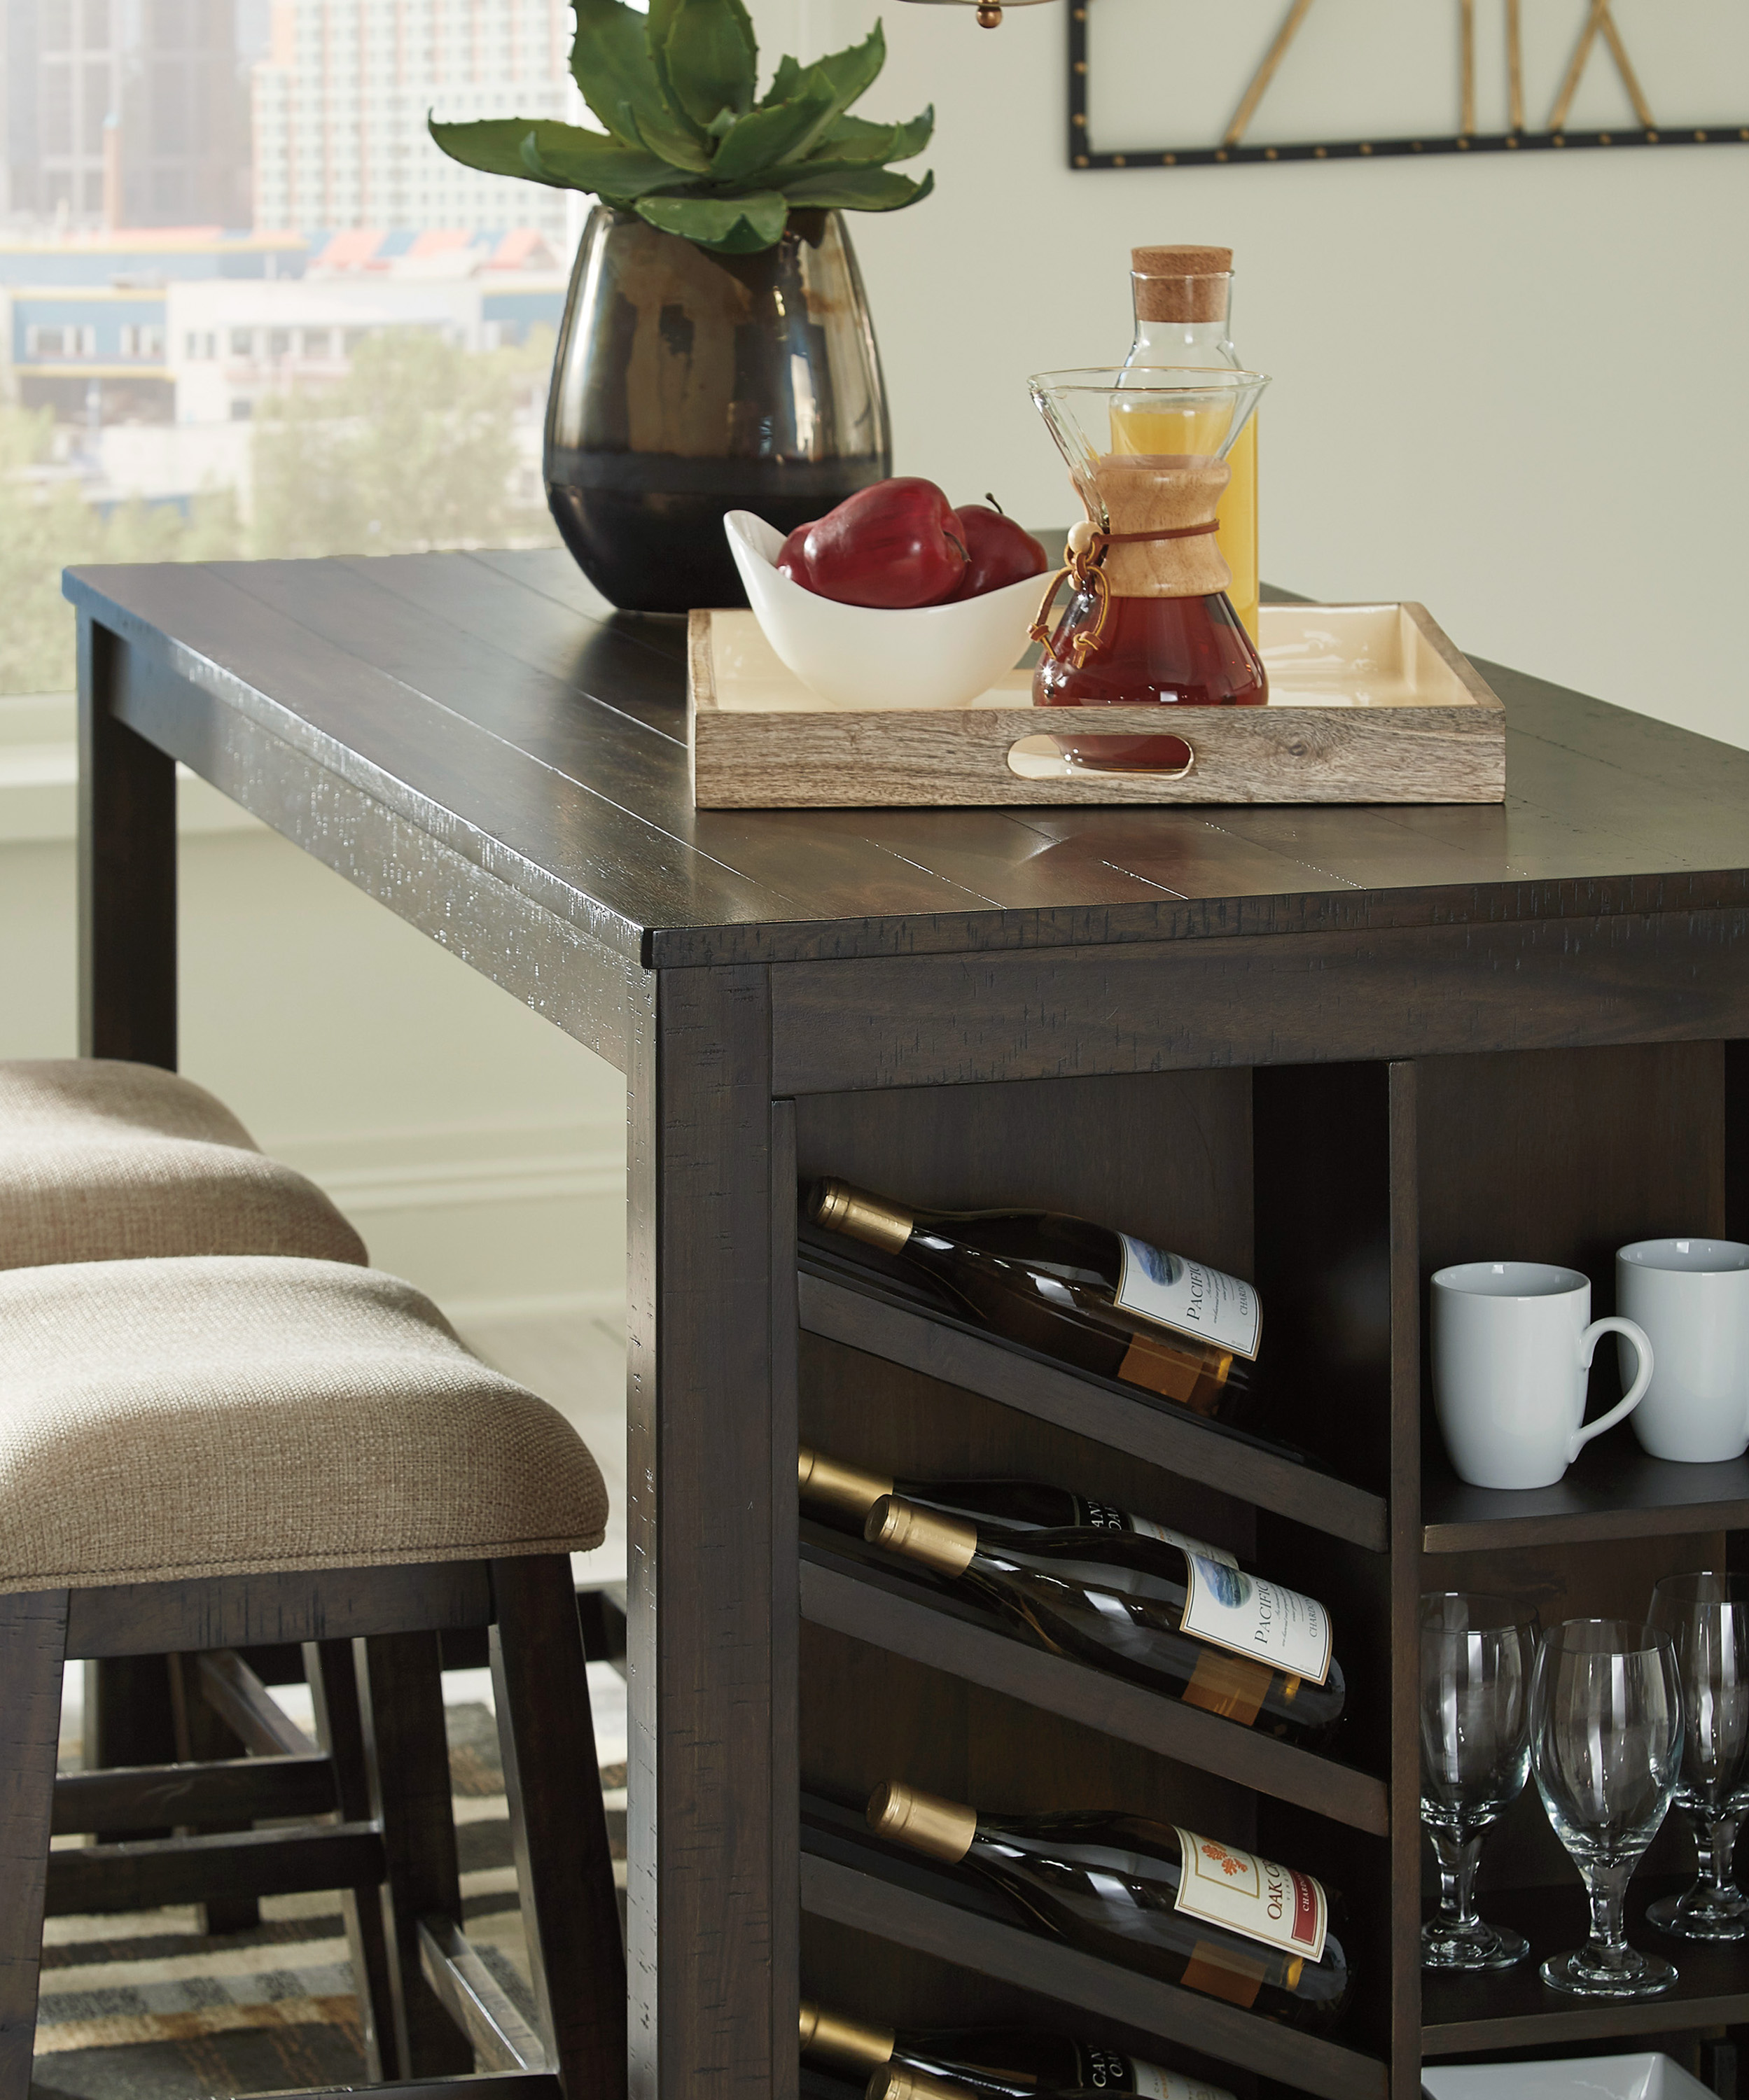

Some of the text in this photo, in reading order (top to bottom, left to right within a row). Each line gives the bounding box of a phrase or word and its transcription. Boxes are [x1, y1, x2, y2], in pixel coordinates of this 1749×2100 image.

[1186, 1262, 1204, 1321] PACIFIC
[1253, 1581, 1272, 1644] PACIFIC
[1267, 1879, 1283, 1919] OAK
